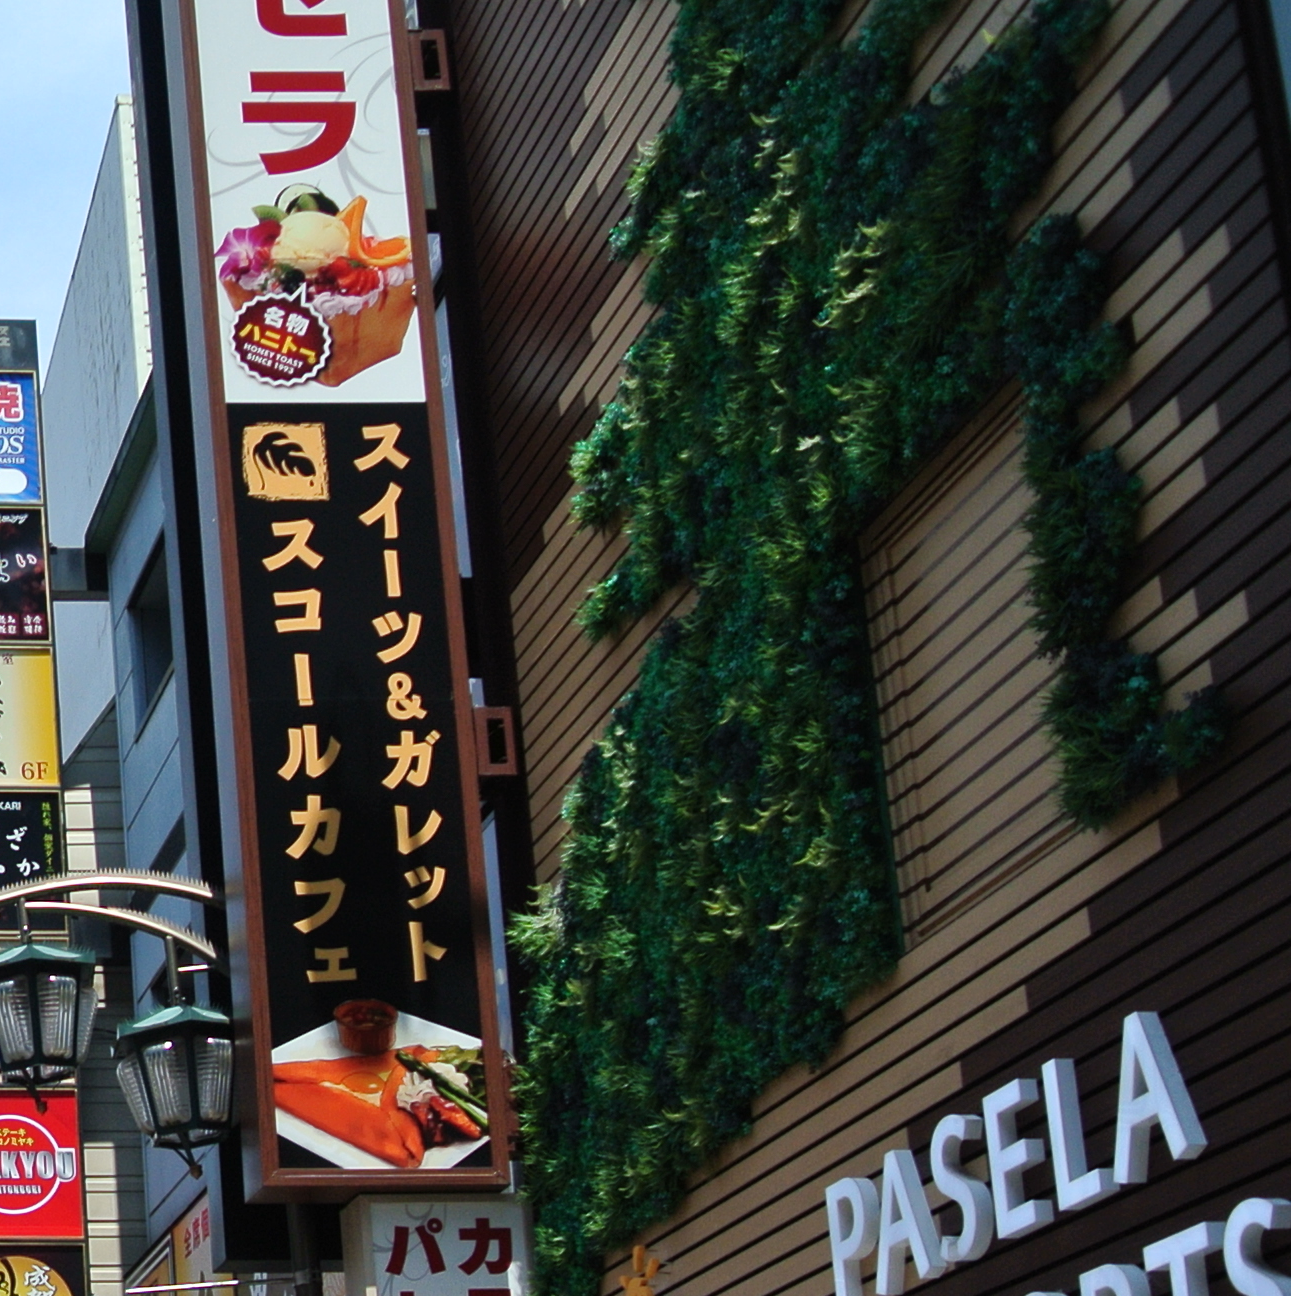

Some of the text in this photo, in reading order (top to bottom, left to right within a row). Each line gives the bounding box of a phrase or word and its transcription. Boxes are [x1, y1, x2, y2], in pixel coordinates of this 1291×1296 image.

[264, 305, 310, 335] 名物
[239, 322, 316, 364] ハニトー
[242, 342, 304, 369] HONEY TOAST
[245, 352, 273, 369] SINCE
[352, 421, 447, 984] スイーツ&ガレット
[260, 517, 357, 985] スコールカフェ
[20, 761, 49, 781] 6F
